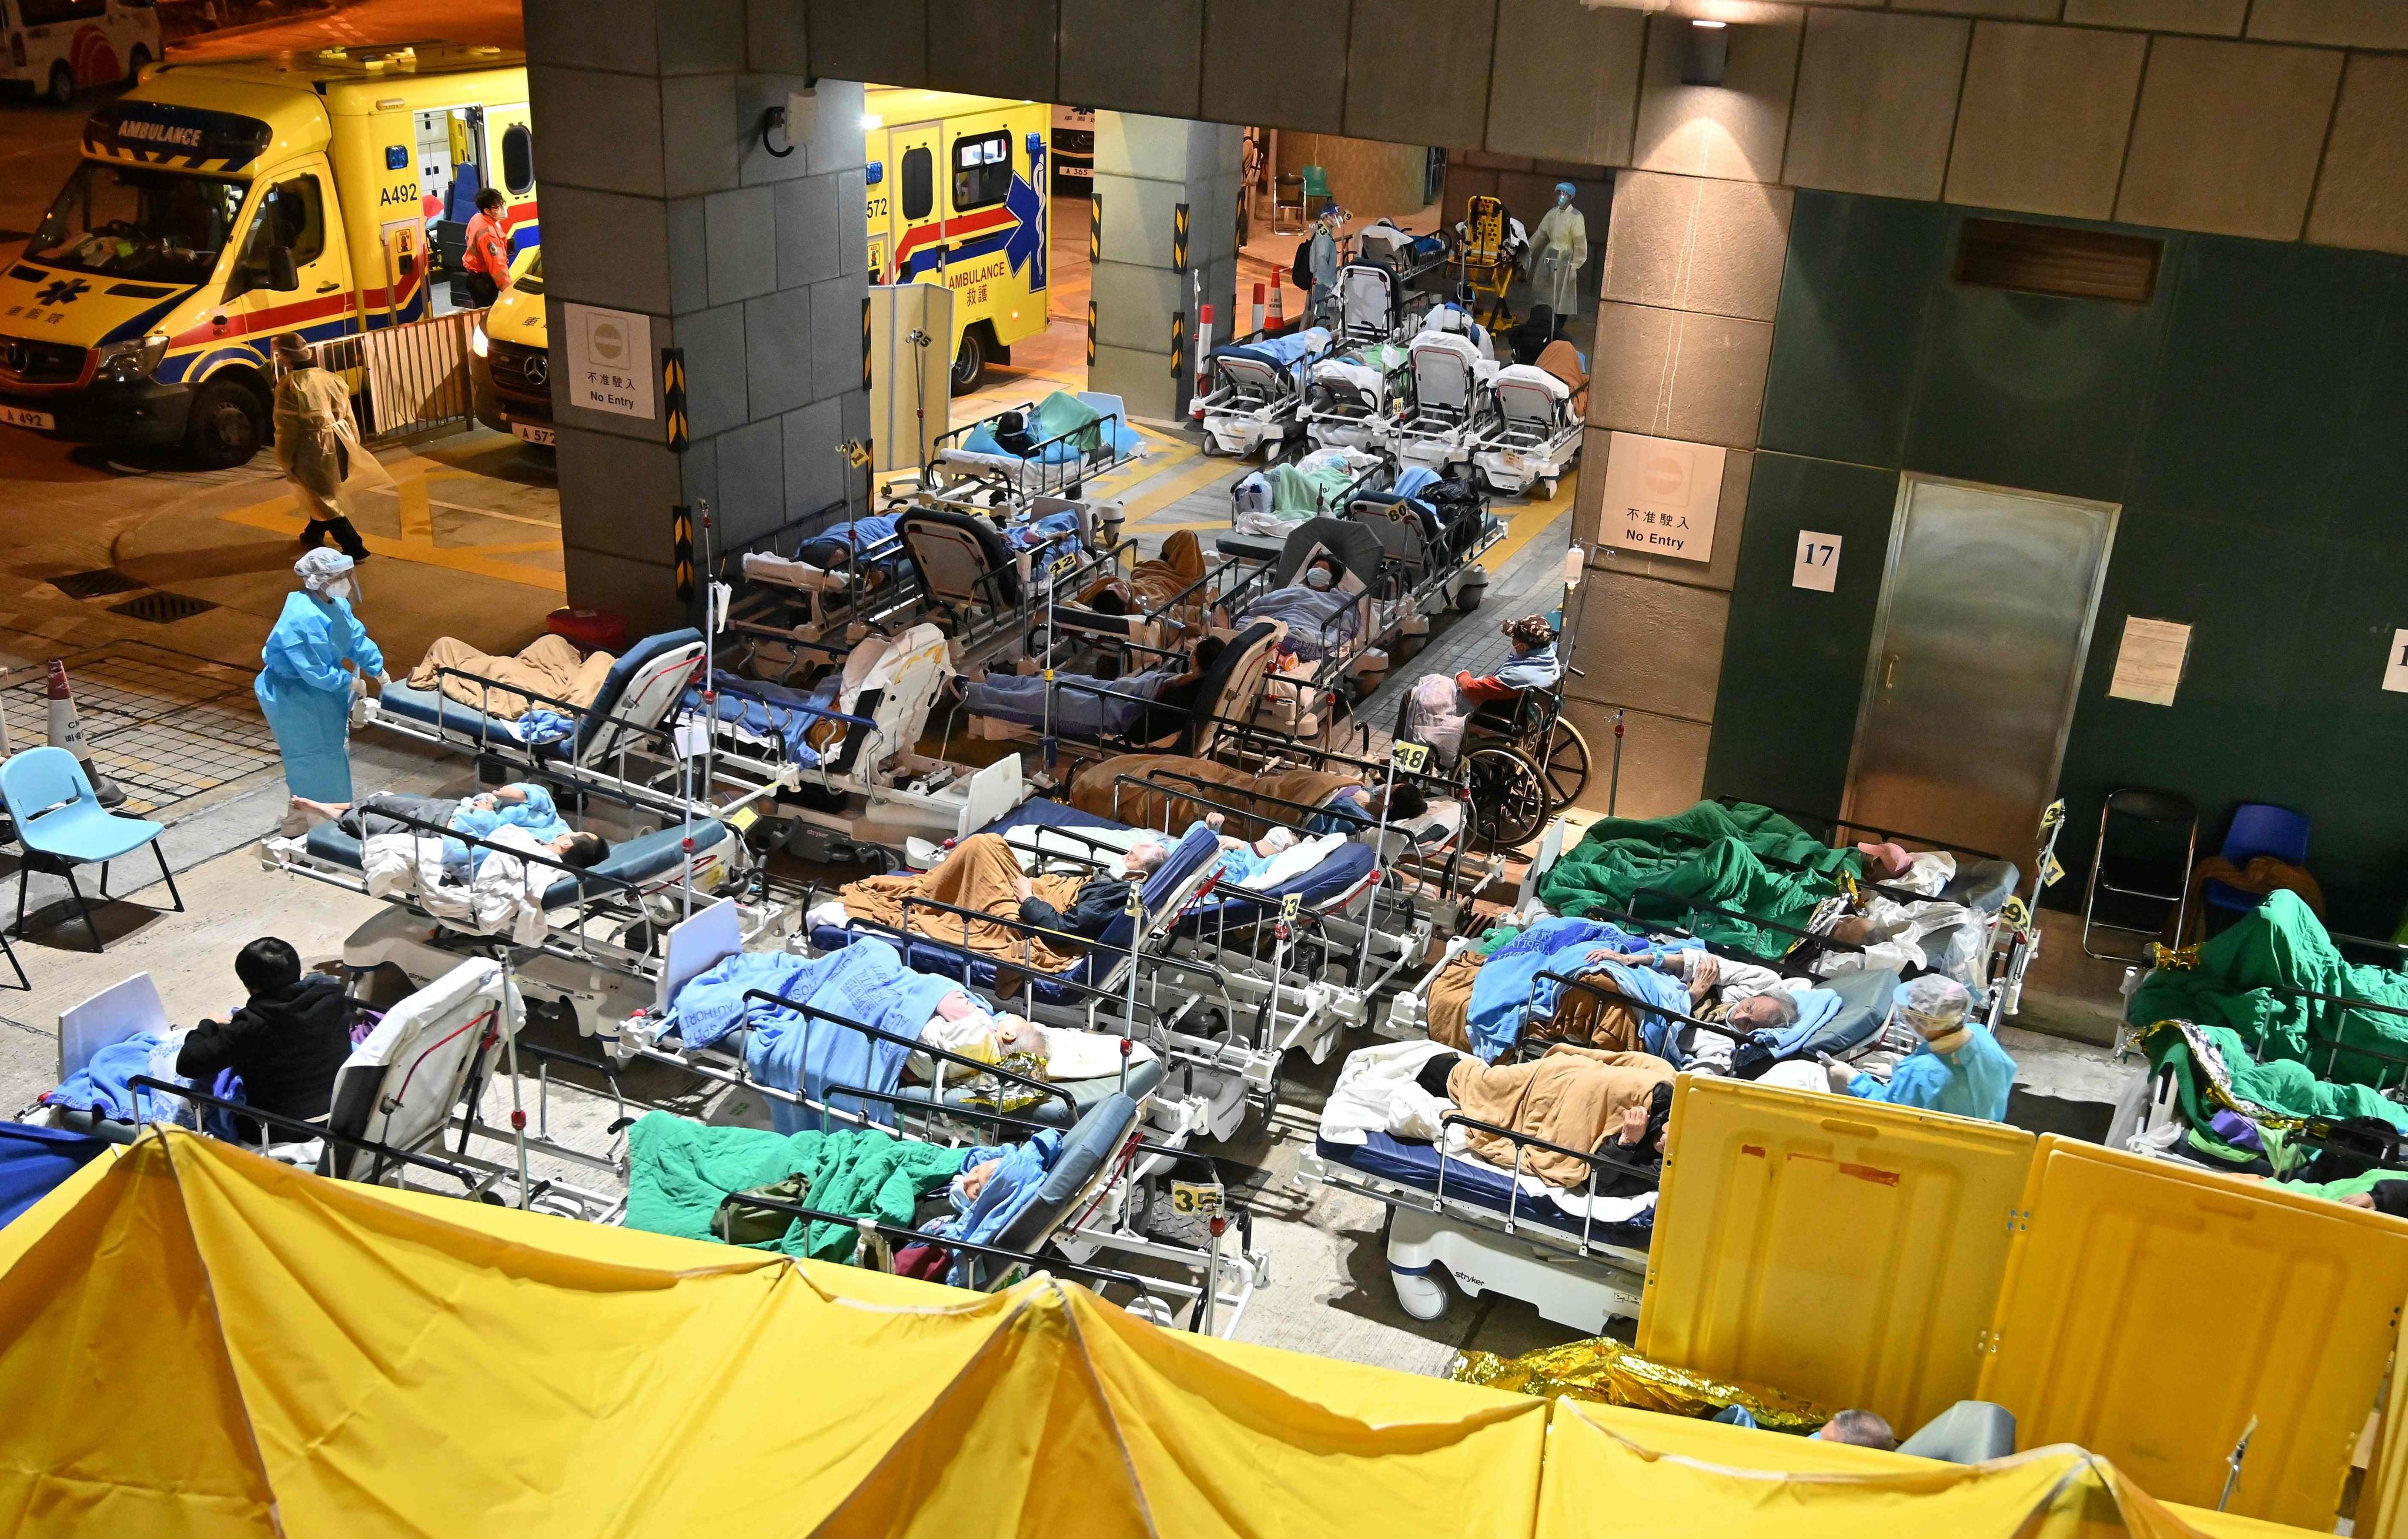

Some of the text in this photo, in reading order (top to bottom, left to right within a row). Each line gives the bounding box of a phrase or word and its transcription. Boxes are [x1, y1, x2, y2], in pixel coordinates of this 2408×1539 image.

[118, 119, 202, 146] AMBULANCE
[380, 183, 417, 206] A492
[867, 198, 887, 219] 572
[1317, 223, 1328, 235] 43
[949, 262, 1005, 289] AMBULANCE
[966, 283, 988, 307] 救護
[587, 372, 636, 390] 不准駛入
[590, 391, 634, 410] No Entry
[7, 410, 42, 426] A 492
[523, 427, 529, 439] A
[1388, 504, 1407, 522] 80
[1626, 508, 1690, 530] 不准駛入
[1626, 529, 1684, 550] No Entry
[1050, 556, 1074, 573] 42
[1802, 543, 1835, 567] 17
[1393, 748, 1424, 768] 48
[1175, 1189, 1216, 1212] 35
[1454, 1271, 1485, 1286] stryker
